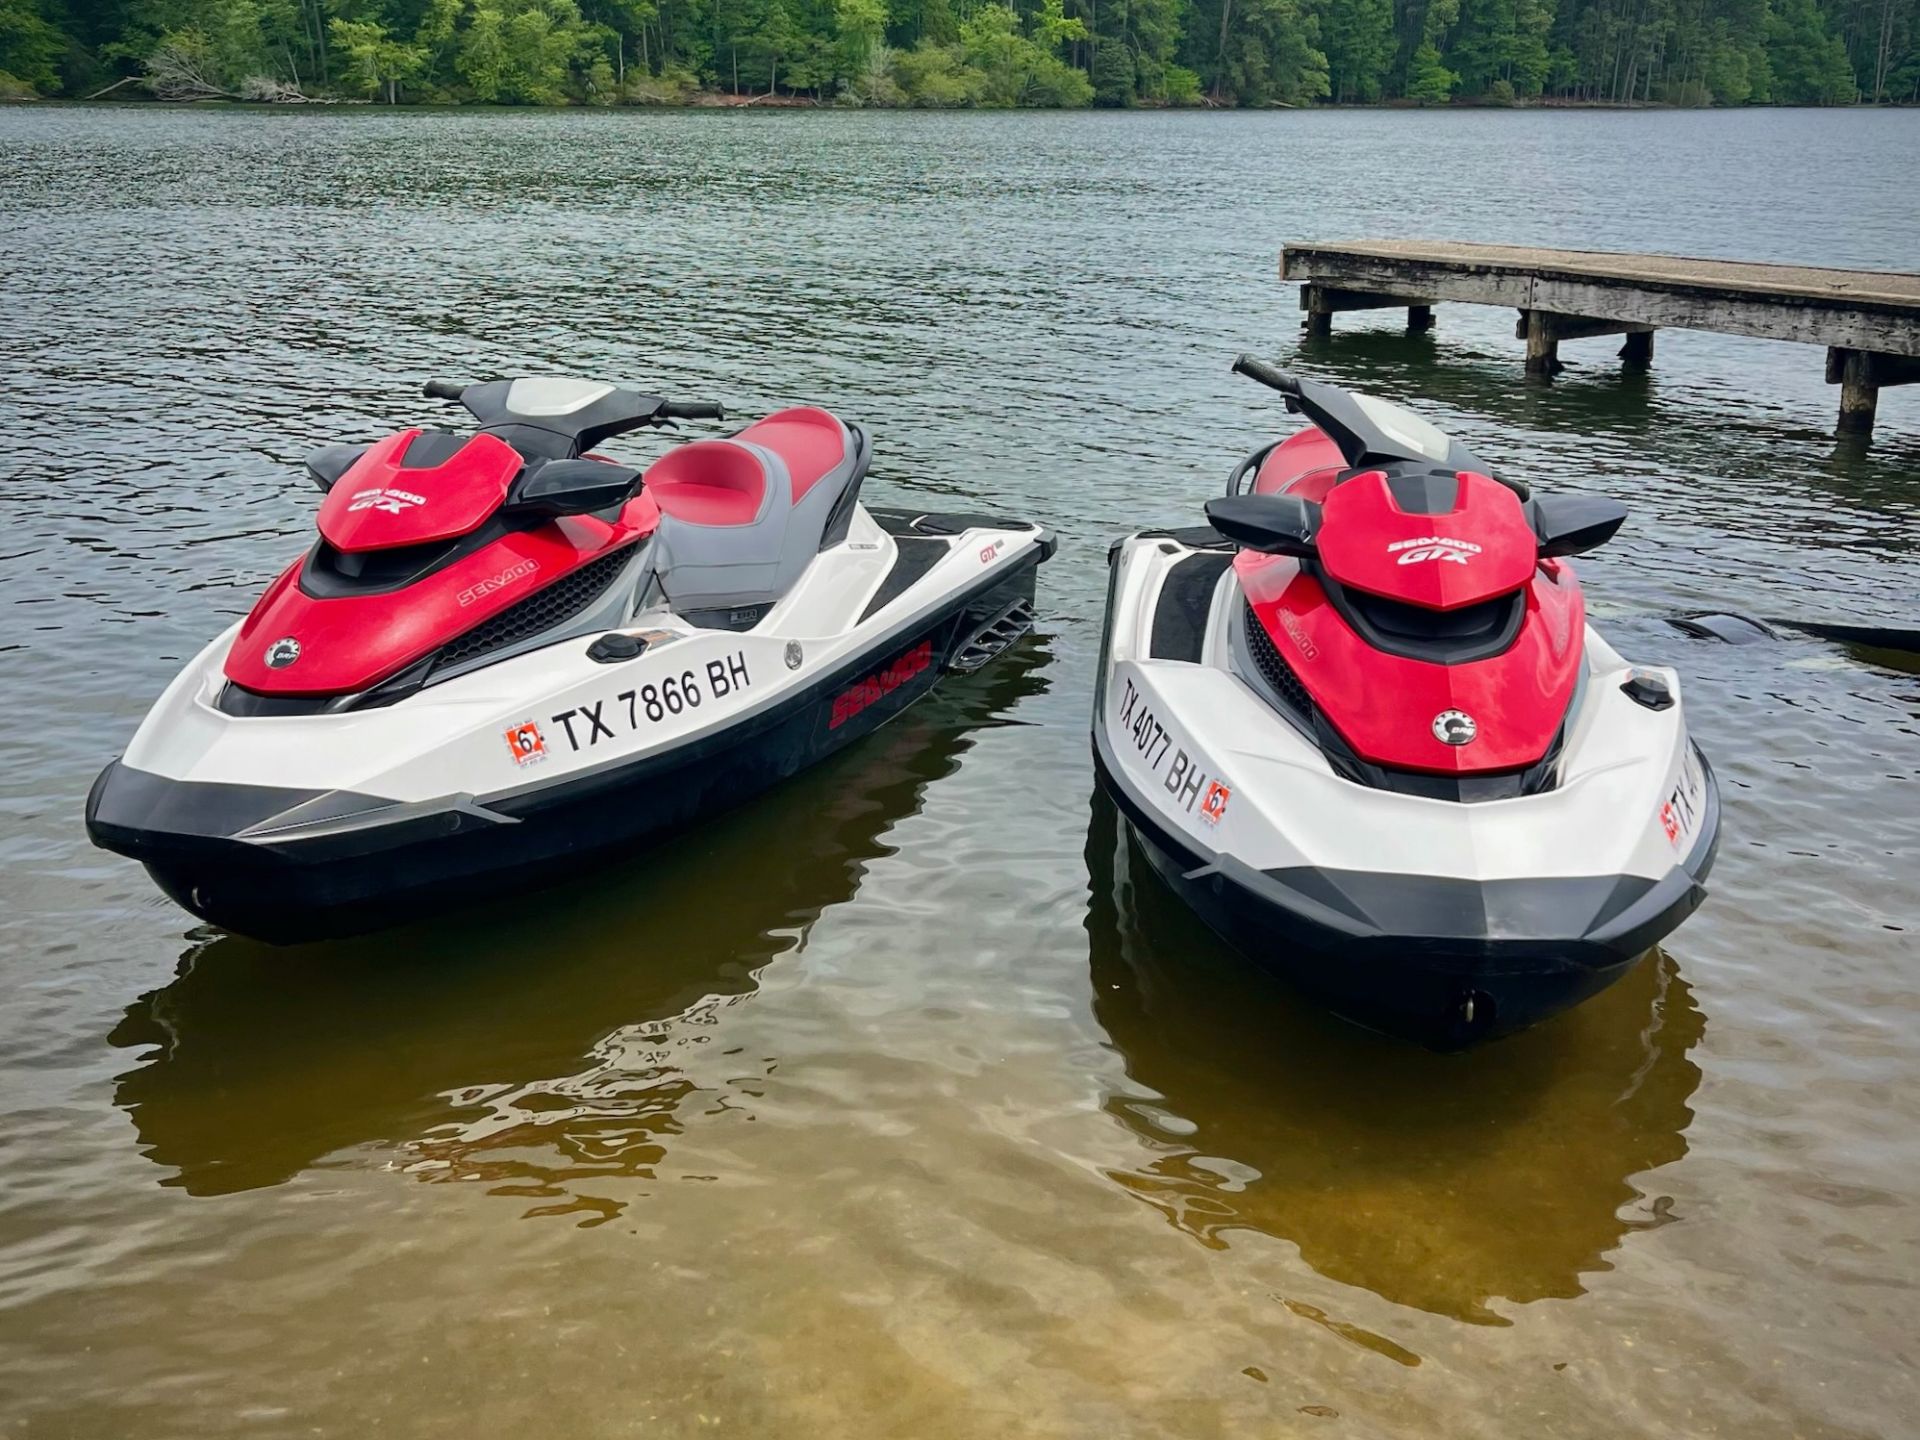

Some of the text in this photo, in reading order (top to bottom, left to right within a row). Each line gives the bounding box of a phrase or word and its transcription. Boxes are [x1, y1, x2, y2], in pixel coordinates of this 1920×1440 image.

[552, 651, 751, 752] TX 7866 BH
[517, 730, 533, 754] 6
[1120, 677, 1206, 813] TX 4077 BH
[1210, 788, 1223, 813] 6
